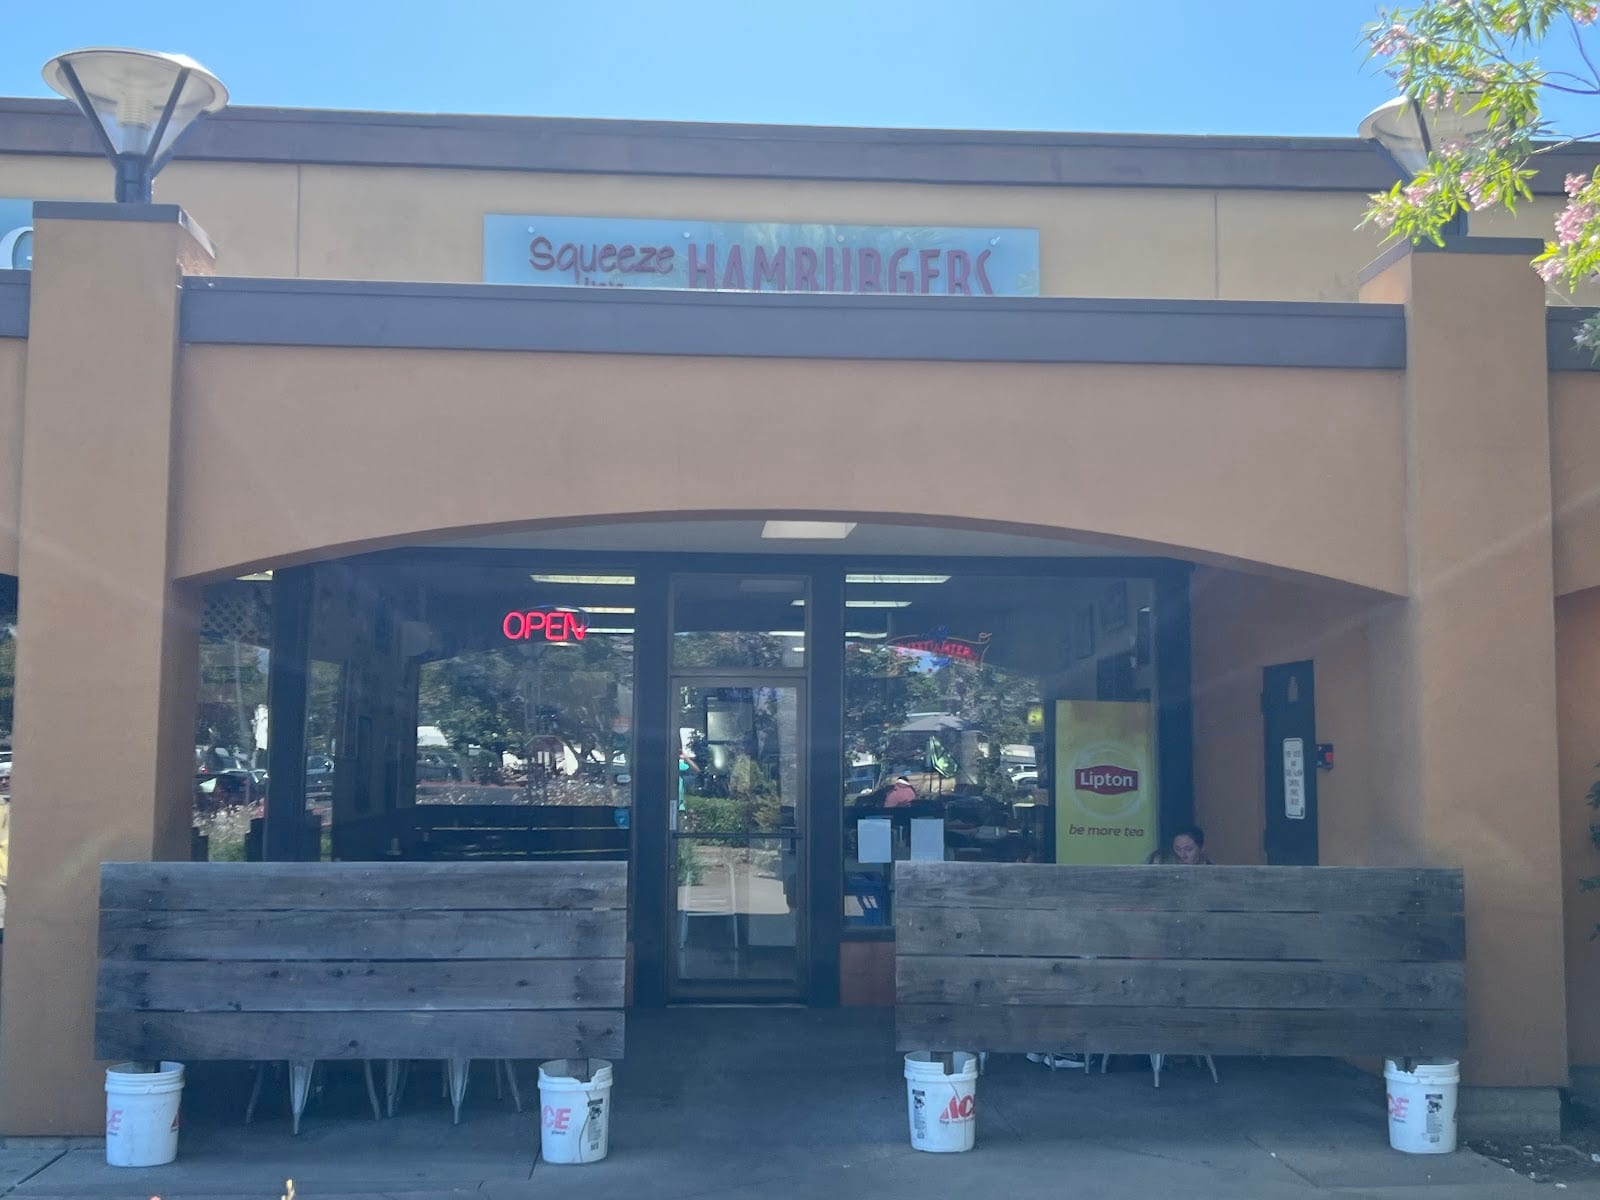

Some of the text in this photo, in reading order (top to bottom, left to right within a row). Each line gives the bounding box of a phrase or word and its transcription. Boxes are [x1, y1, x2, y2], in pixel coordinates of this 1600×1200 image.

[529, 236, 675, 284] Squeeze
[503, 611, 585, 641] OPEN
[1080, 771, 1133, 789] Lipton
[1069, 823, 1144, 838] be more tea
[939, 1094, 976, 1119] AC
